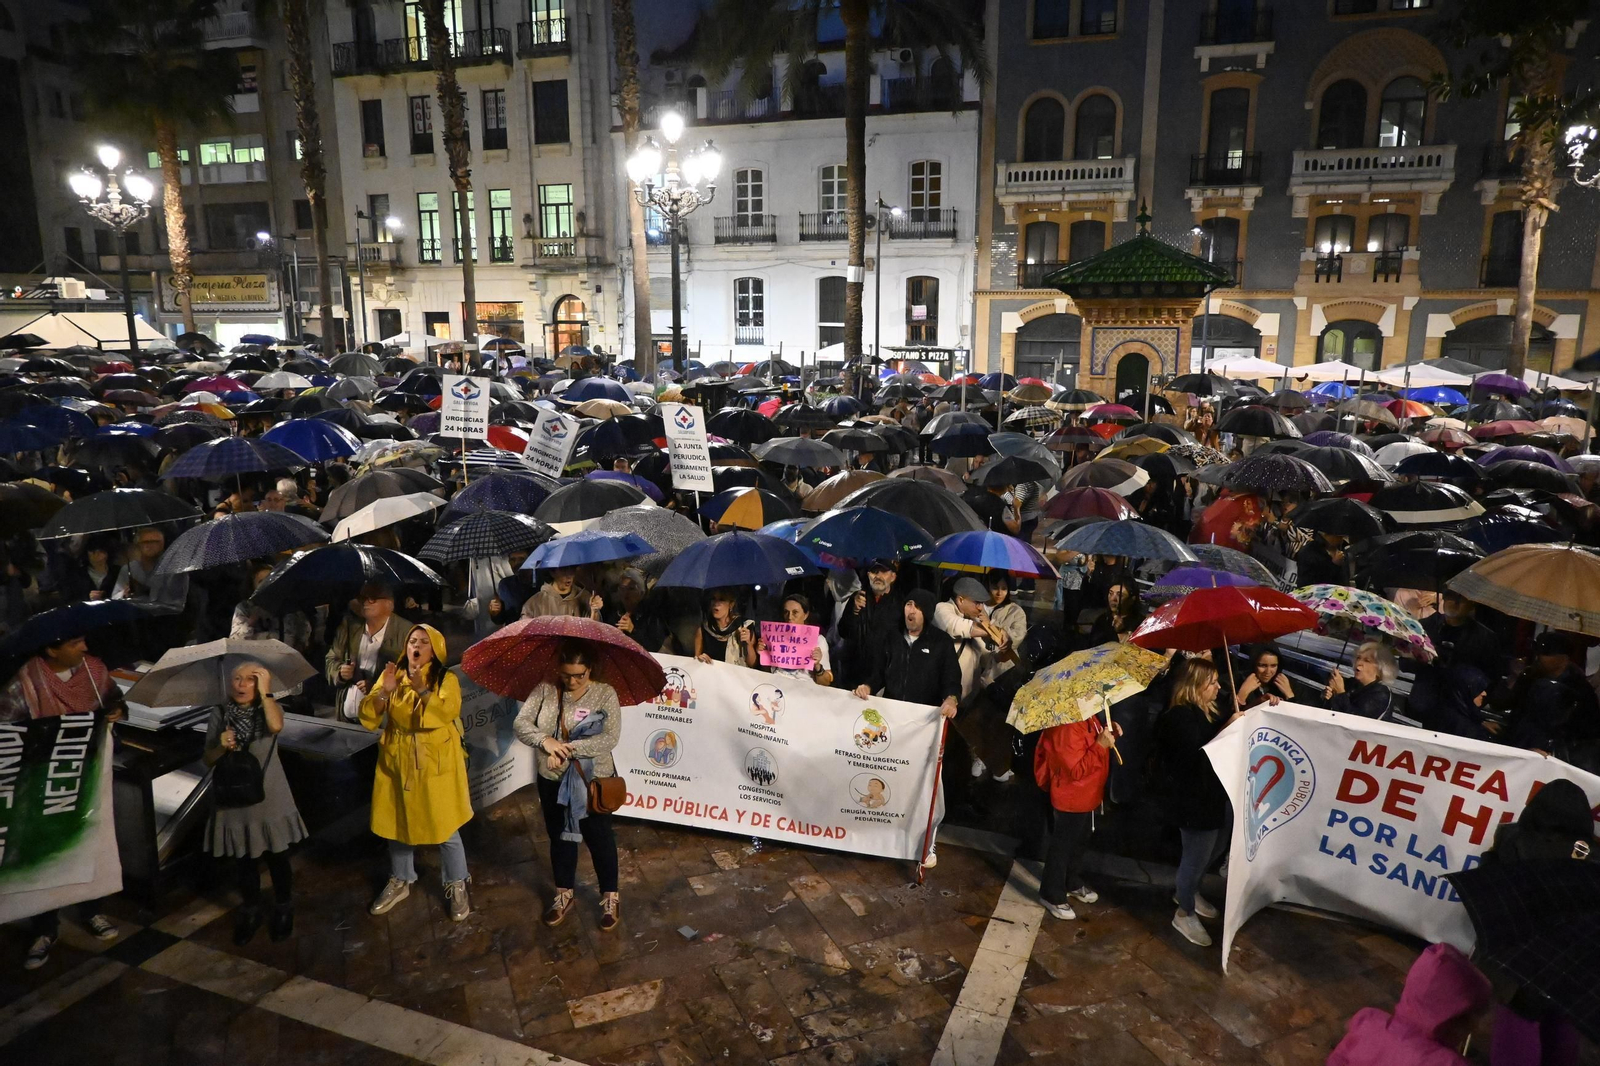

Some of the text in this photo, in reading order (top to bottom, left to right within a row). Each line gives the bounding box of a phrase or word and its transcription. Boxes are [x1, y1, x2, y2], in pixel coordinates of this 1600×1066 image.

[232, 276, 266, 290] Plaza
[928, 351, 949, 361] PIZZA
[445, 415, 484, 423] URGENCIAS
[444, 424, 484, 434] 24 HORAS
[529, 445, 562, 463] URGENCIAS
[673, 453, 707, 461] PERJUDICA
[525, 454, 559, 473] 24 HORAS
[673, 464, 709, 472] SERIAMENTE
[775, 624, 797, 633] VIDA
[765, 634, 785, 643] VALE
[779, 644, 797, 654] TUS
[770, 654, 811, 666] RECORTES
[657, 705, 683, 714] ESPERAS
[645, 713, 693, 724] INTERMINABLES
[749, 722, 777, 734] HOSPITAL
[737, 727, 789, 746] MATERNO-INFANTIL
[1257, 731, 1305, 766] BLANCA
[834, 749, 862, 760] RETRASO
[872, 756, 910, 766] URGENCIAS
[852, 761, 898, 772] EMERGENCIAS
[1348, 739, 1509, 803] MAREA
[629, 767, 691, 782] ATENCIÓN PRIMARIA
[649, 780, 677, 789] HUMANA
[738, 784, 776, 797] CONGESTIÓN
[740, 793, 782, 806] LOS SERVICIOS
[1280, 780, 1311, 816] PÚBLICA
[840, 807, 867, 815] CIRUGÍA
[868, 810, 900, 818] TORÁCICA
[1335, 768, 1515, 846] DE H
[624, 792, 847, 840] DAD PÚBLICA Y DE CALIDAD
[854, 816, 892, 825] PEDIÁTRICA
[1326, 808, 1483, 872] POR LA D
[1318, 834, 1358, 866] LA
[1368, 852, 1463, 903] SANI
